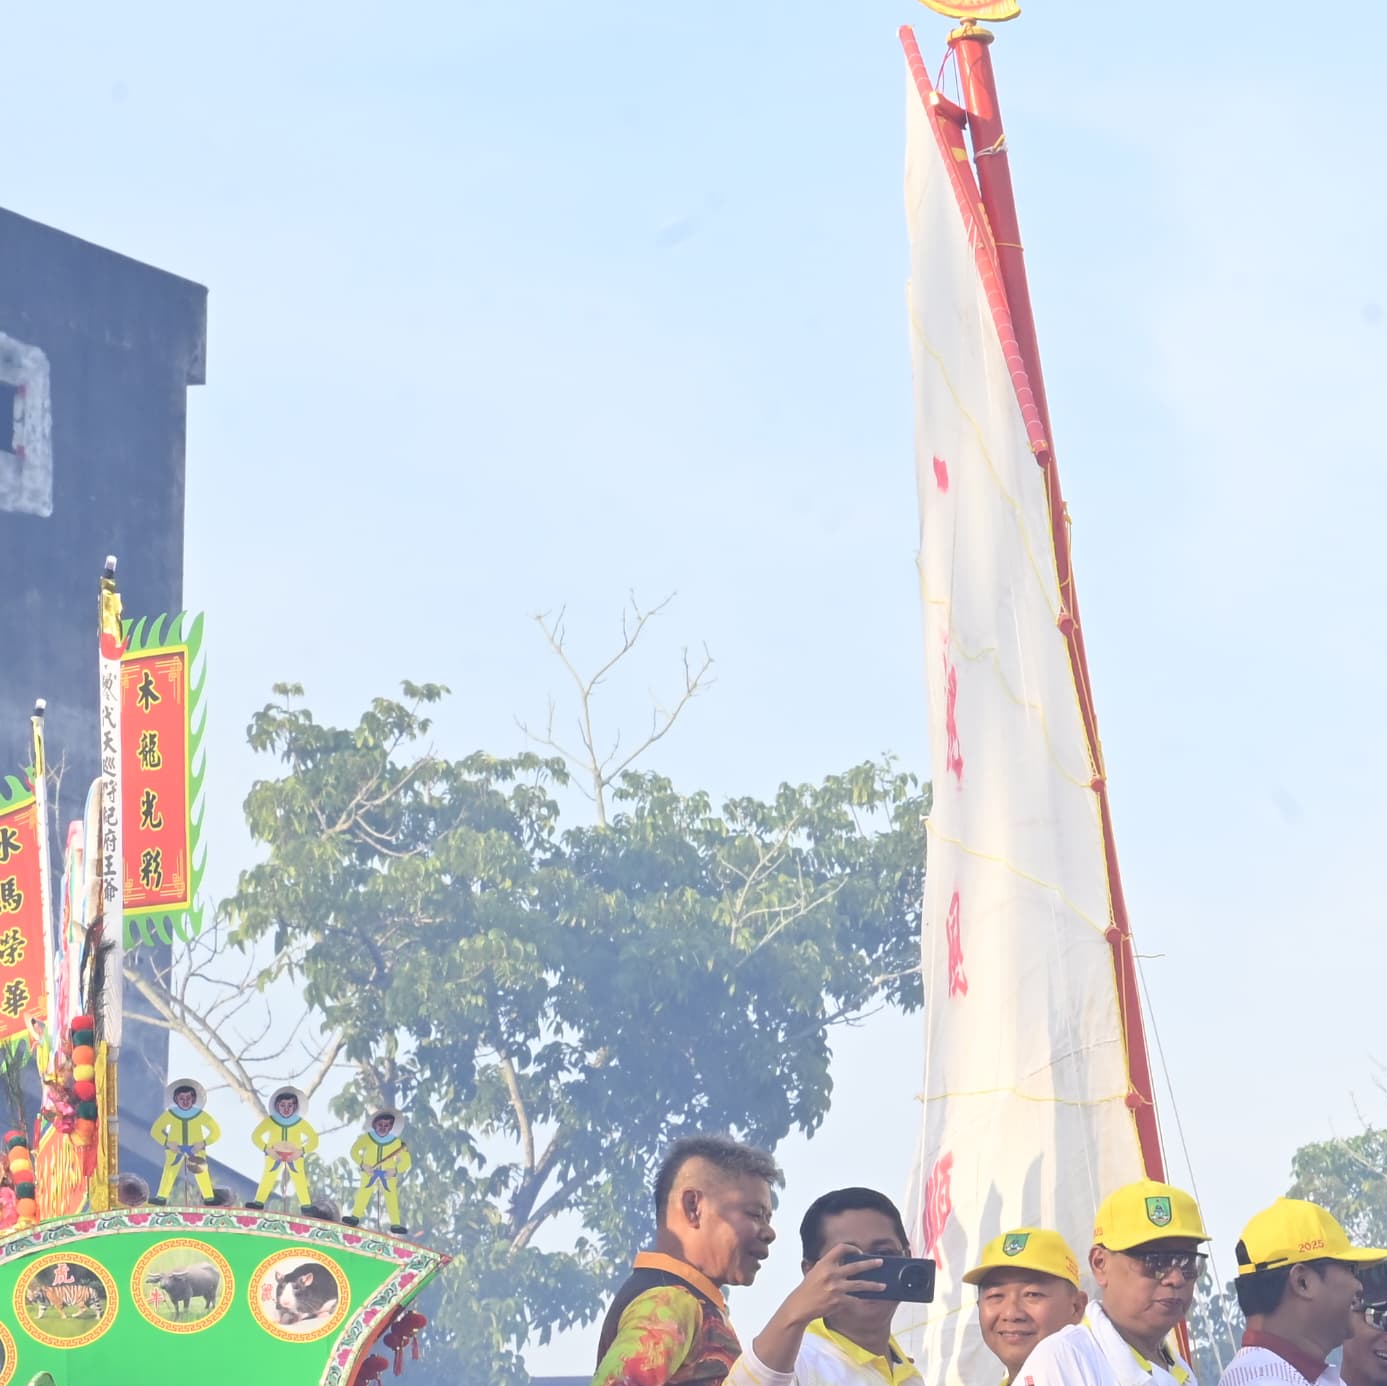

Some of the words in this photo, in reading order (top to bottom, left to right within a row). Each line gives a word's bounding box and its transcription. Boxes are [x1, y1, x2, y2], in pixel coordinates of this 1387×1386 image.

[138, 672, 163, 889] 木龍光彩
[1298, 1240, 1324, 1253] 2025
